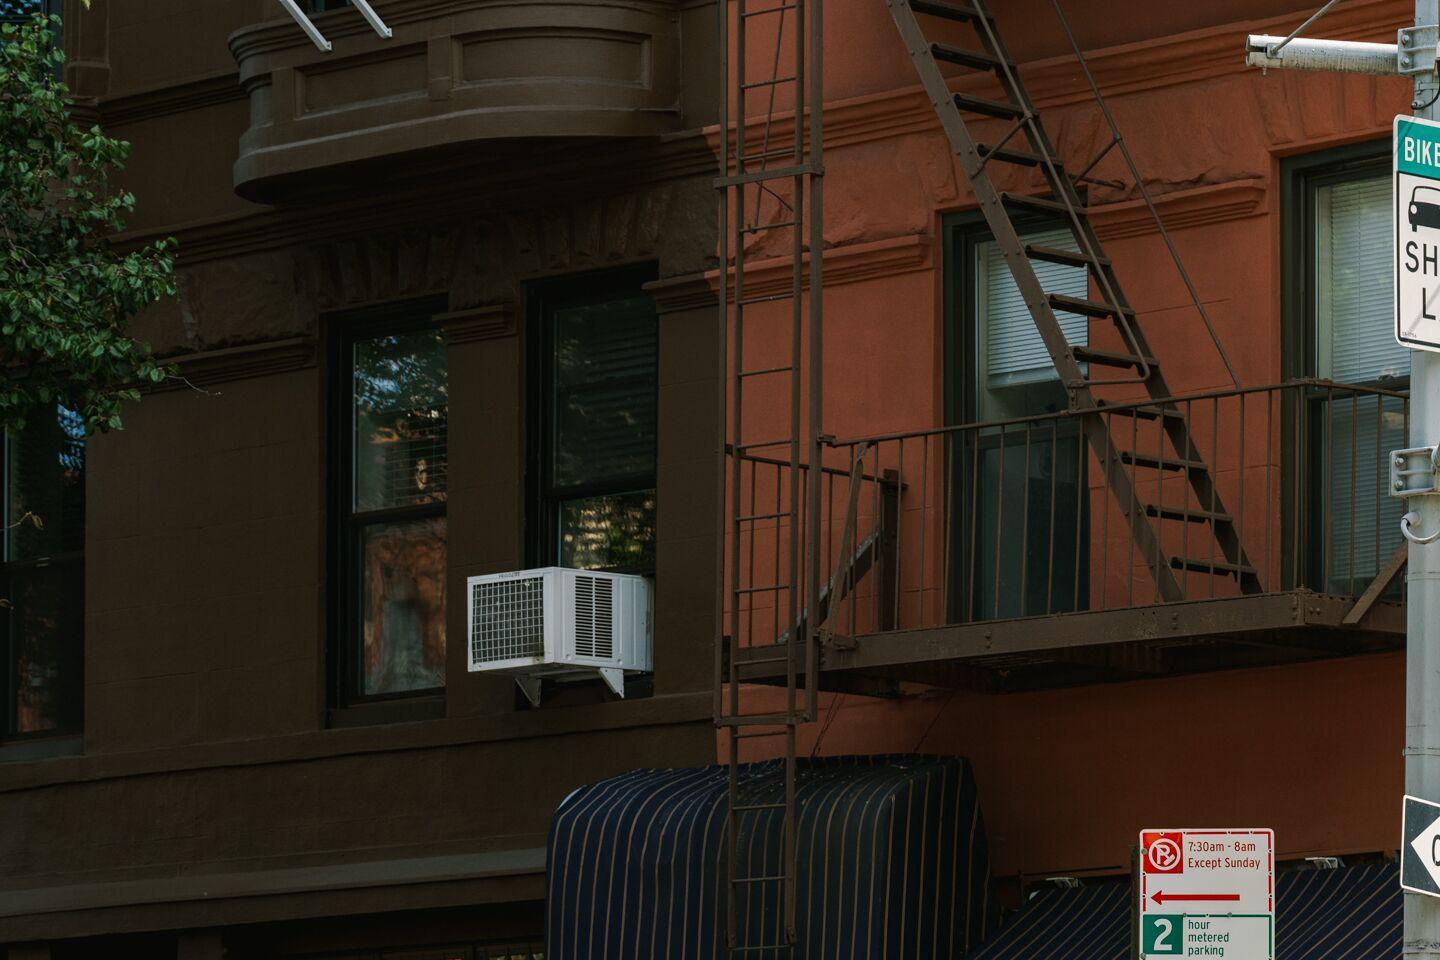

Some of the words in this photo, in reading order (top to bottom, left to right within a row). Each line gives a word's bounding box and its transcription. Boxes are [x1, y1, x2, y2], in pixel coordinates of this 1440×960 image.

[1188, 842, 1225, 852] 7:30am
[1234, 842, 1256, 852] 8am
[1188, 858, 1222, 870] Except
[1224, 857, 1260, 870] Sunday
[1188, 919, 1210, 930] hour
[1153, 918, 1172, 951] 2
[1188, 932, 1229, 942] metered
[1188, 944, 1224, 957] parking
